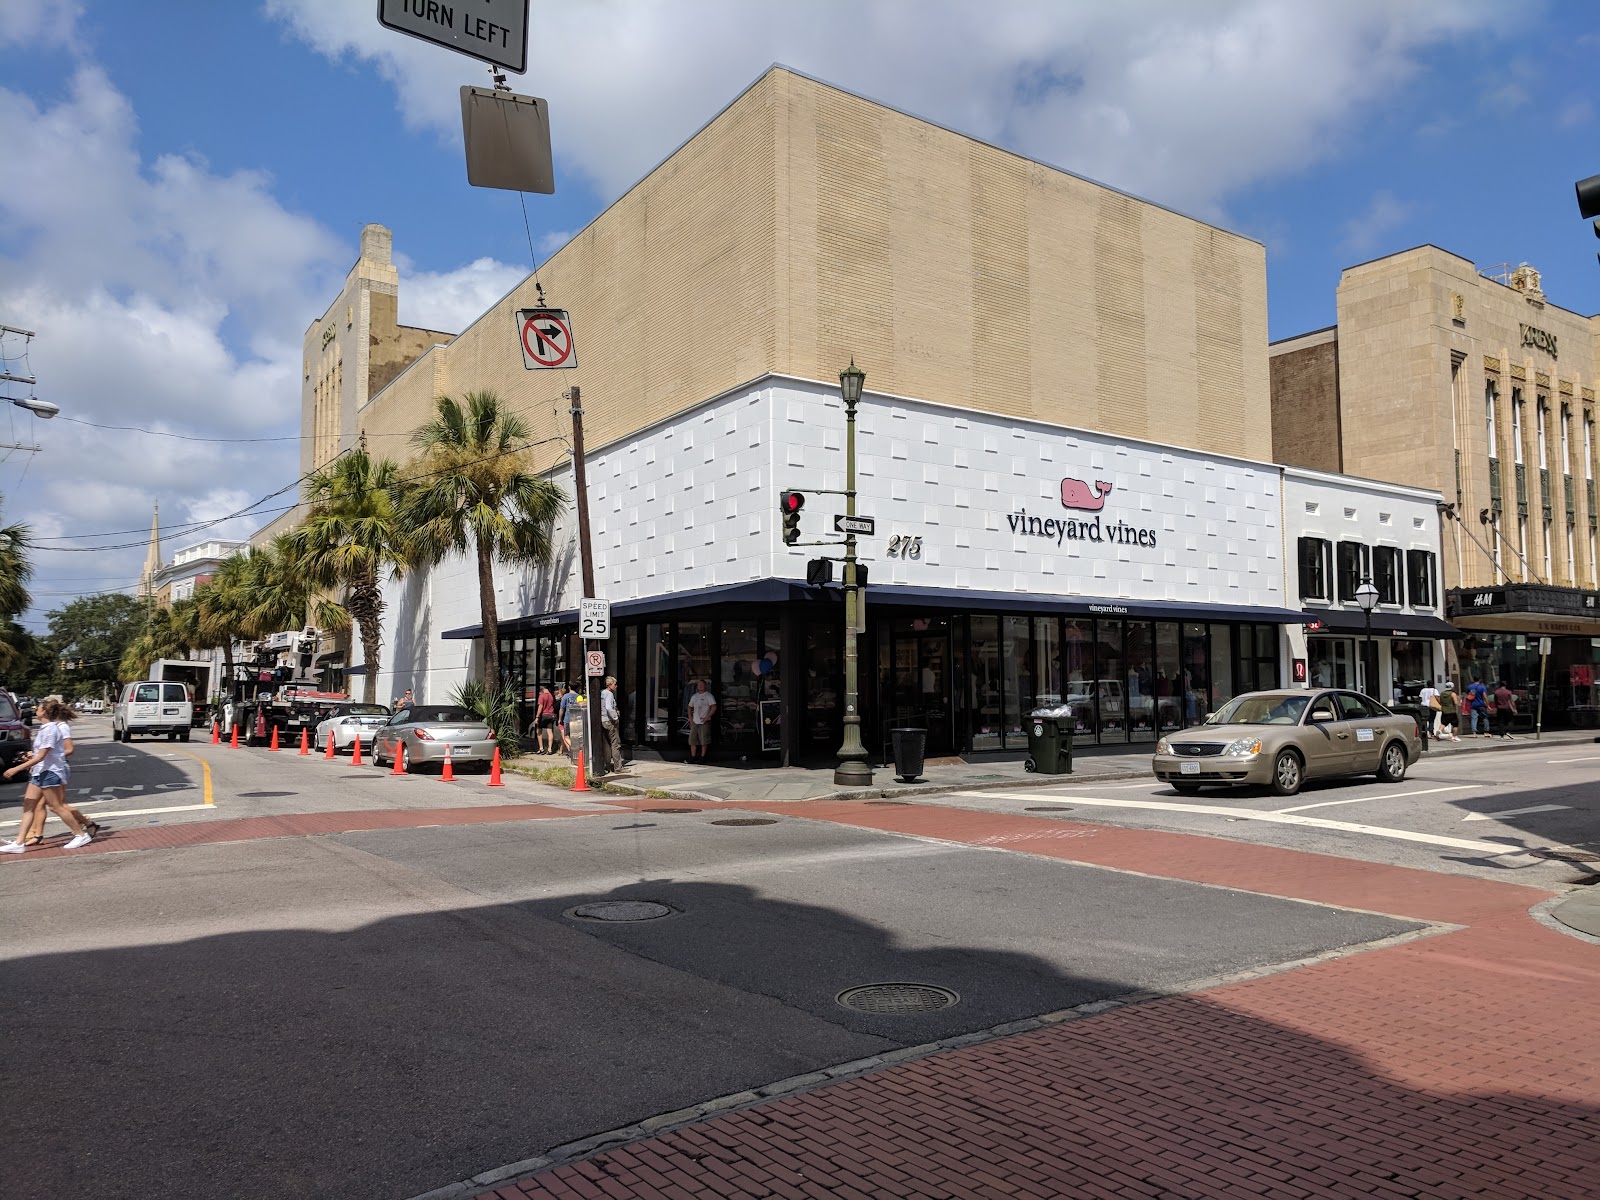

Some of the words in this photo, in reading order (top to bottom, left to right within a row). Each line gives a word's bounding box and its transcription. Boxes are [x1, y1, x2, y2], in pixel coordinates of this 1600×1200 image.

[464, 13, 510, 48] LEFT
[845, 521, 857, 529] ONE
[859, 523, 871, 531] WAY
[1007, 508, 1104, 547] vineyard
[1105, 520, 1157, 547] vines
[886, 534, 923, 556] 275
[583, 602, 607, 610] SPEED
[1089, 603, 1113, 614] vineyard
[1113, 605, 1128, 613] vines
[583, 619, 606, 633] 25
